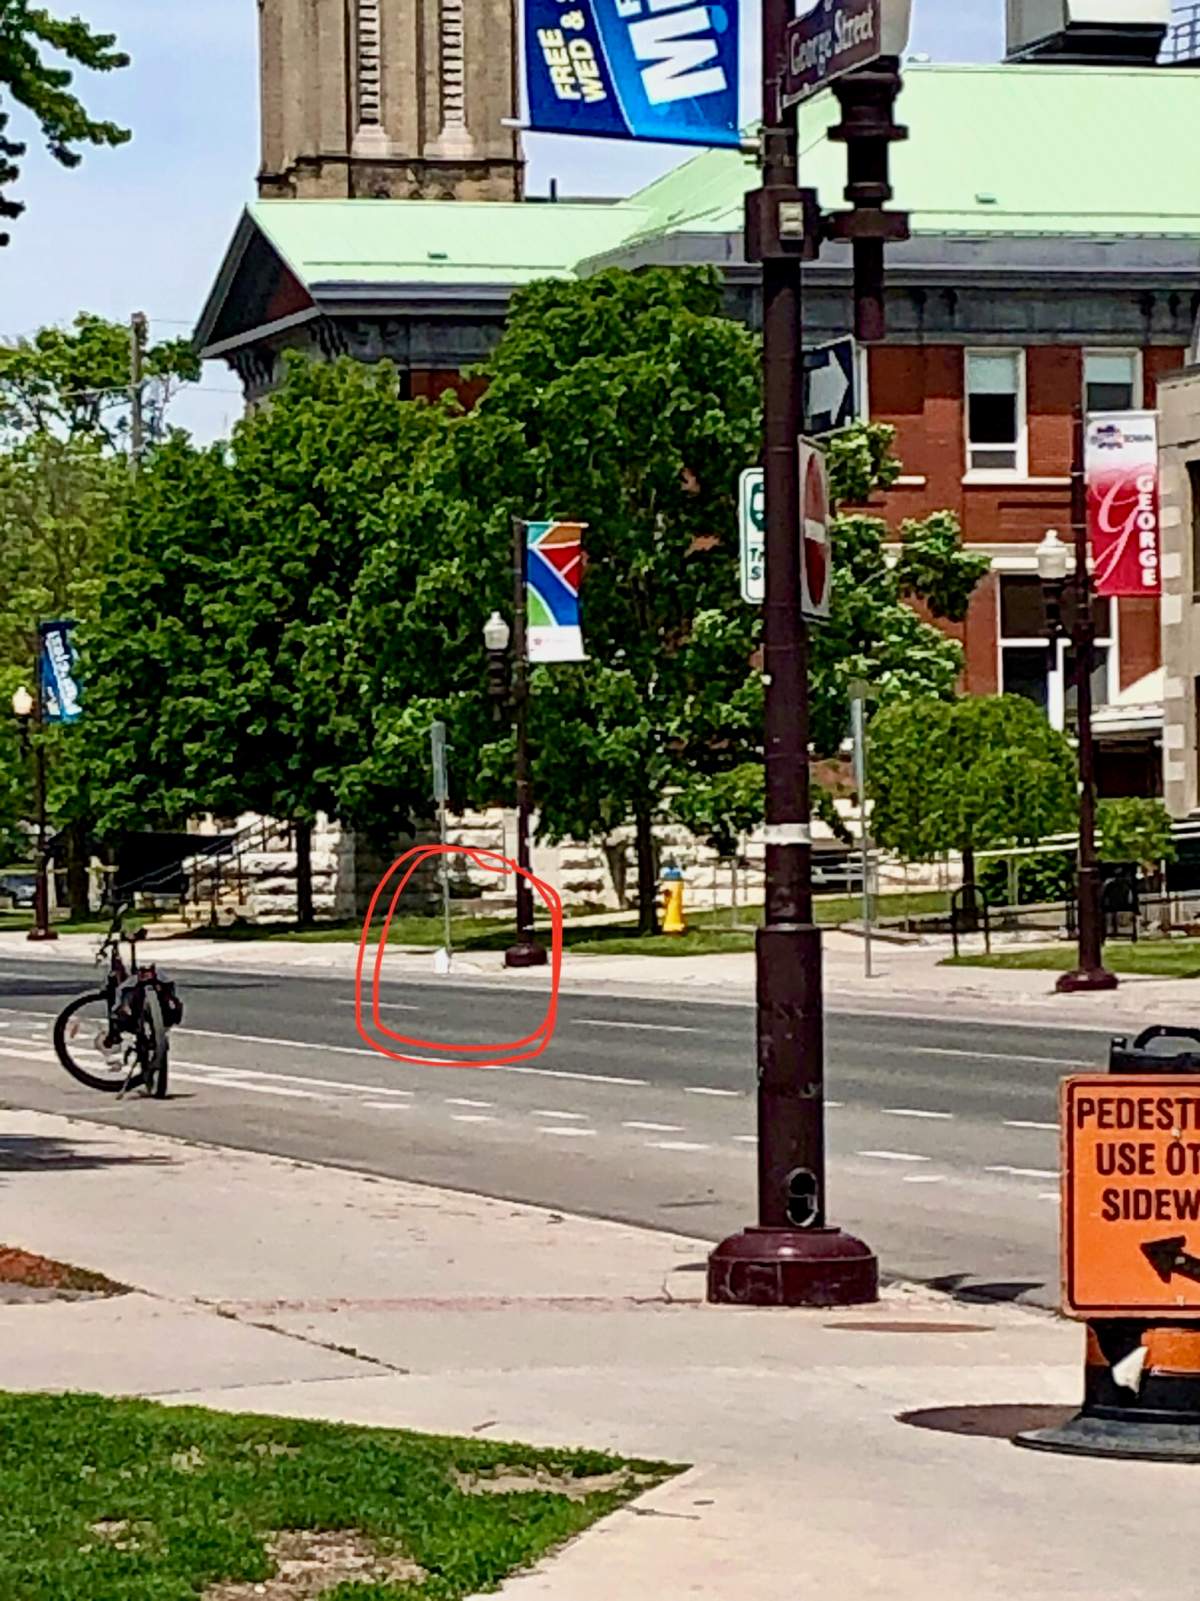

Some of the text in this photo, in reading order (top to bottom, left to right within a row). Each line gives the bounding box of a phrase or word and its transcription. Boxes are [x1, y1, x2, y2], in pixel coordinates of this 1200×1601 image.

[560, 9, 585, 31] &
[791, 2, 874, 76] George Street
[537, 28, 582, 100] FREE
[568, 38, 607, 103] WED
[1136, 474, 1158, 587] GEORGE
[1096, 1143, 1156, 1176] USE
